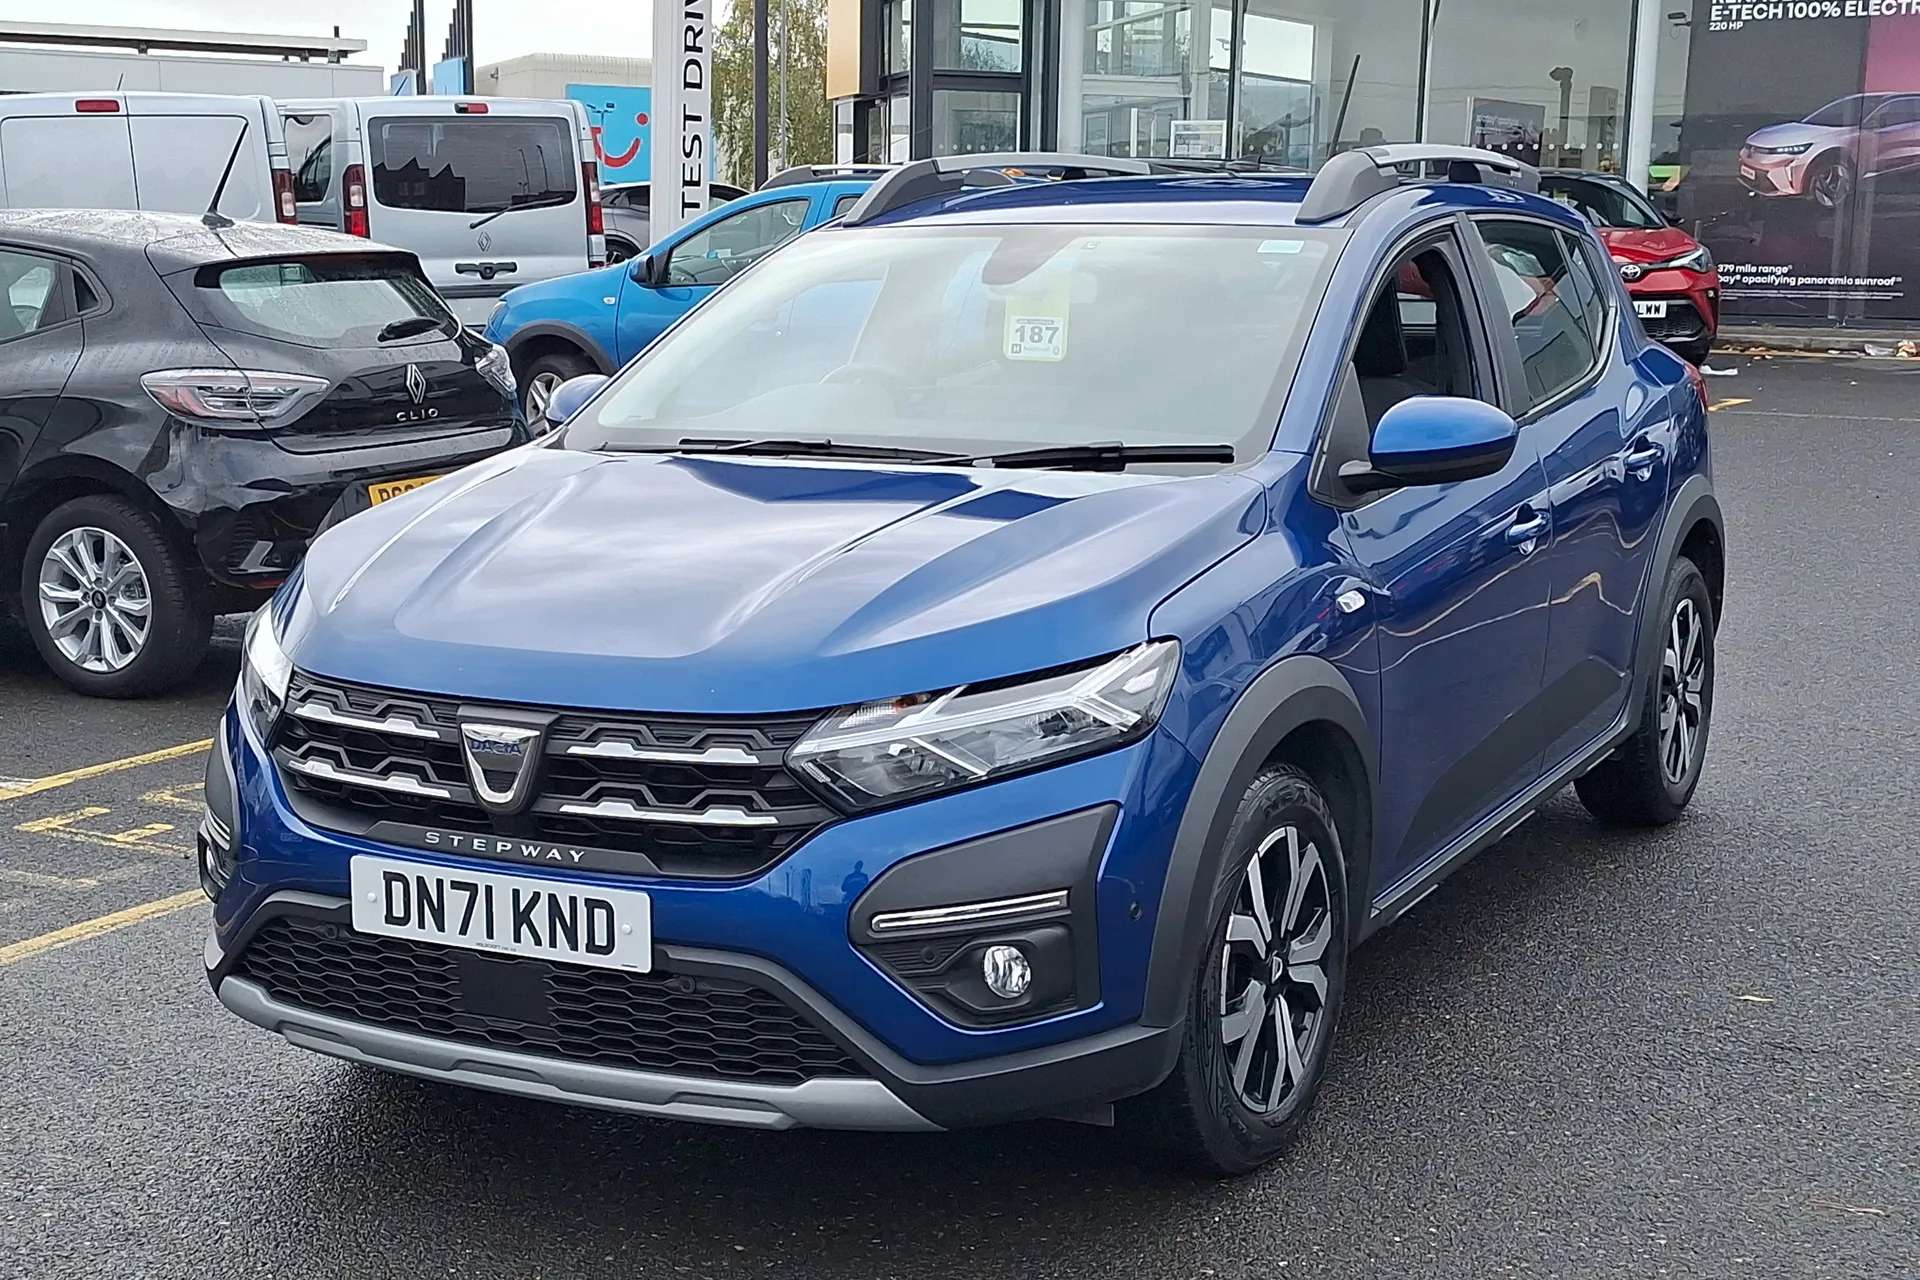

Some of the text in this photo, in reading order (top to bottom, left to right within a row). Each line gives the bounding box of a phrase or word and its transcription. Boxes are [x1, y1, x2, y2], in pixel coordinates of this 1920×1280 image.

[1710, 3, 1784, 21] E-TECH
[1786, 1, 1841, 19] 100%
[1709, 21, 1744, 31] 220 HP
[682, 0, 704, 219] TEST DRI
[1717, 264, 1735, 273] 379
[1735, 264, 1758, 273] mile
[1742, 275, 1796, 286] opacifying
[1797, 276, 1854, 286] panoramic
[1015, 325, 1060, 345] 187
[396, 408, 439, 421] CLIO
[470, 739, 522, 755] DACIA
[425, 831, 585, 863] STEPWAY
[382, 870, 616, 956] DN71 KND
